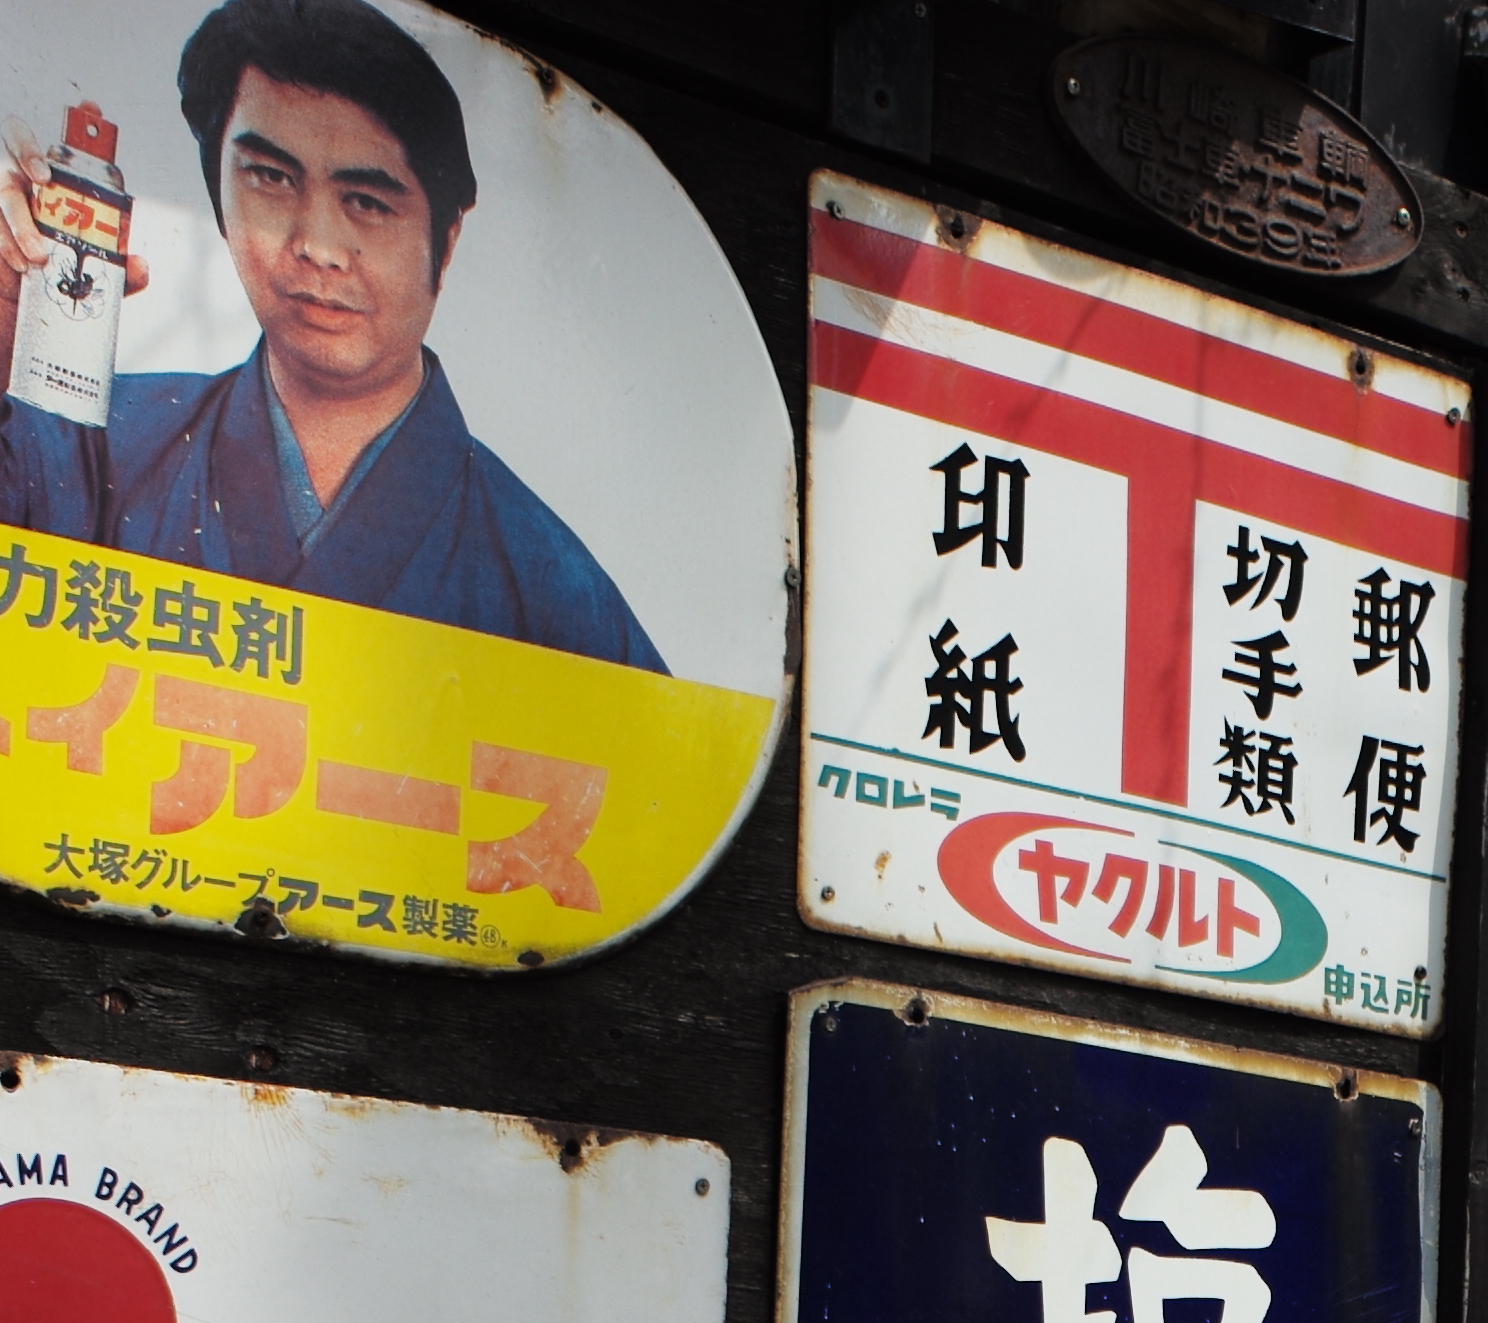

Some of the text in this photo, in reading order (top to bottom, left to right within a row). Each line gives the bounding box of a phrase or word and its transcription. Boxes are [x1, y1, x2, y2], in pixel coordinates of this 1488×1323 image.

[922, 442, 1030, 763] 印紙
[1216, 525, 1309, 826] 切手類
[1343, 566, 1437, 853] 郵便
[818, 764, 962, 821] クロレラ
[1018, 839, 1262, 958] ヤクルト
[1323, 961, 1431, 1022] 申込所
[93, 1166, 200, 1278] BRAND
